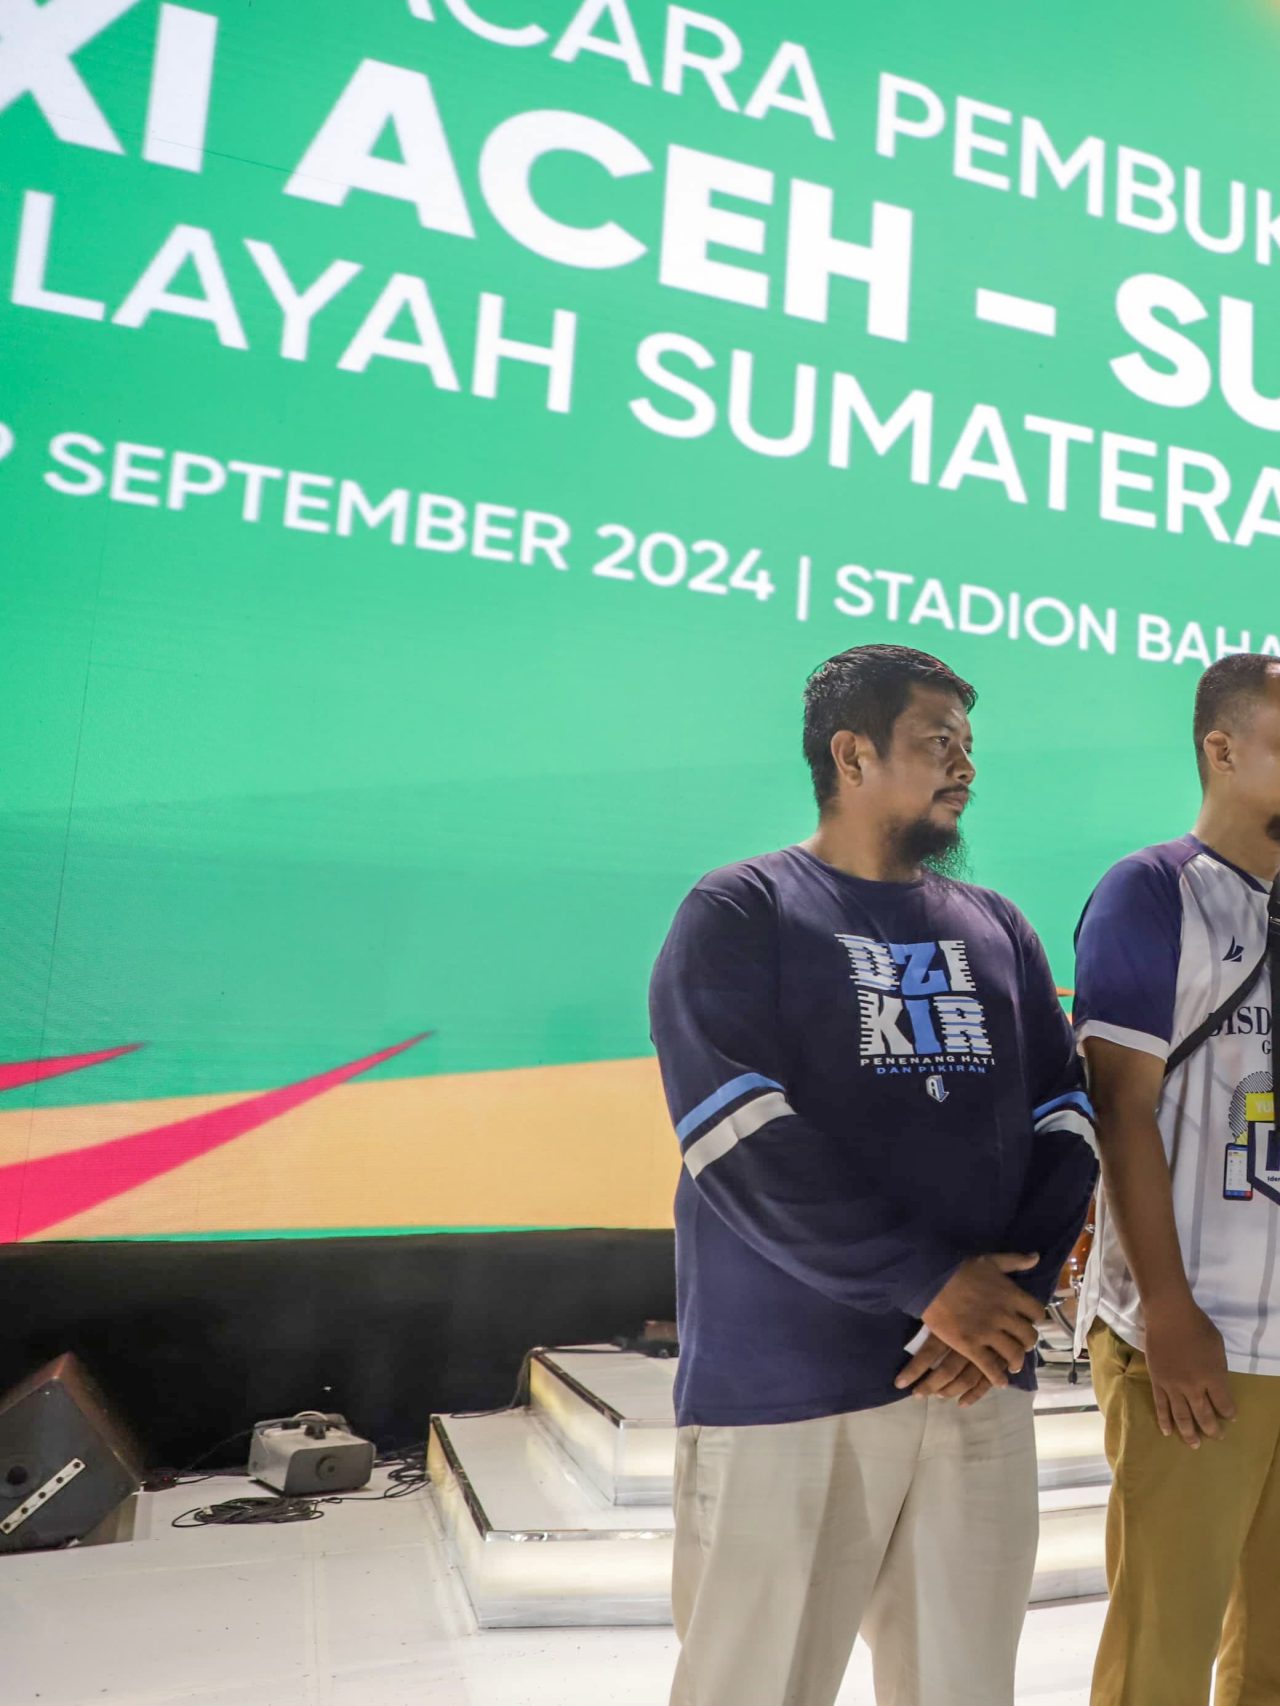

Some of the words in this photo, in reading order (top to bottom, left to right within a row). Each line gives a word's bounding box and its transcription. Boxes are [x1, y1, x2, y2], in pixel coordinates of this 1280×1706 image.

[409, 0, 835, 141] CARA
[283, 58, 914, 343] ACEH
[11, 190, 577, 414] LAYAH
[44, 432, 571, 571] SEPTEMBER
[592, 523, 776, 602] 2024
[834, 564, 1118, 655] STADION
[860, 1055, 955, 1066] PENENANG
[961, 1055, 996, 1065] HATI
[876, 1066, 912, 1075] DAN
[918, 1065, 987, 1074] PIKIRAN
